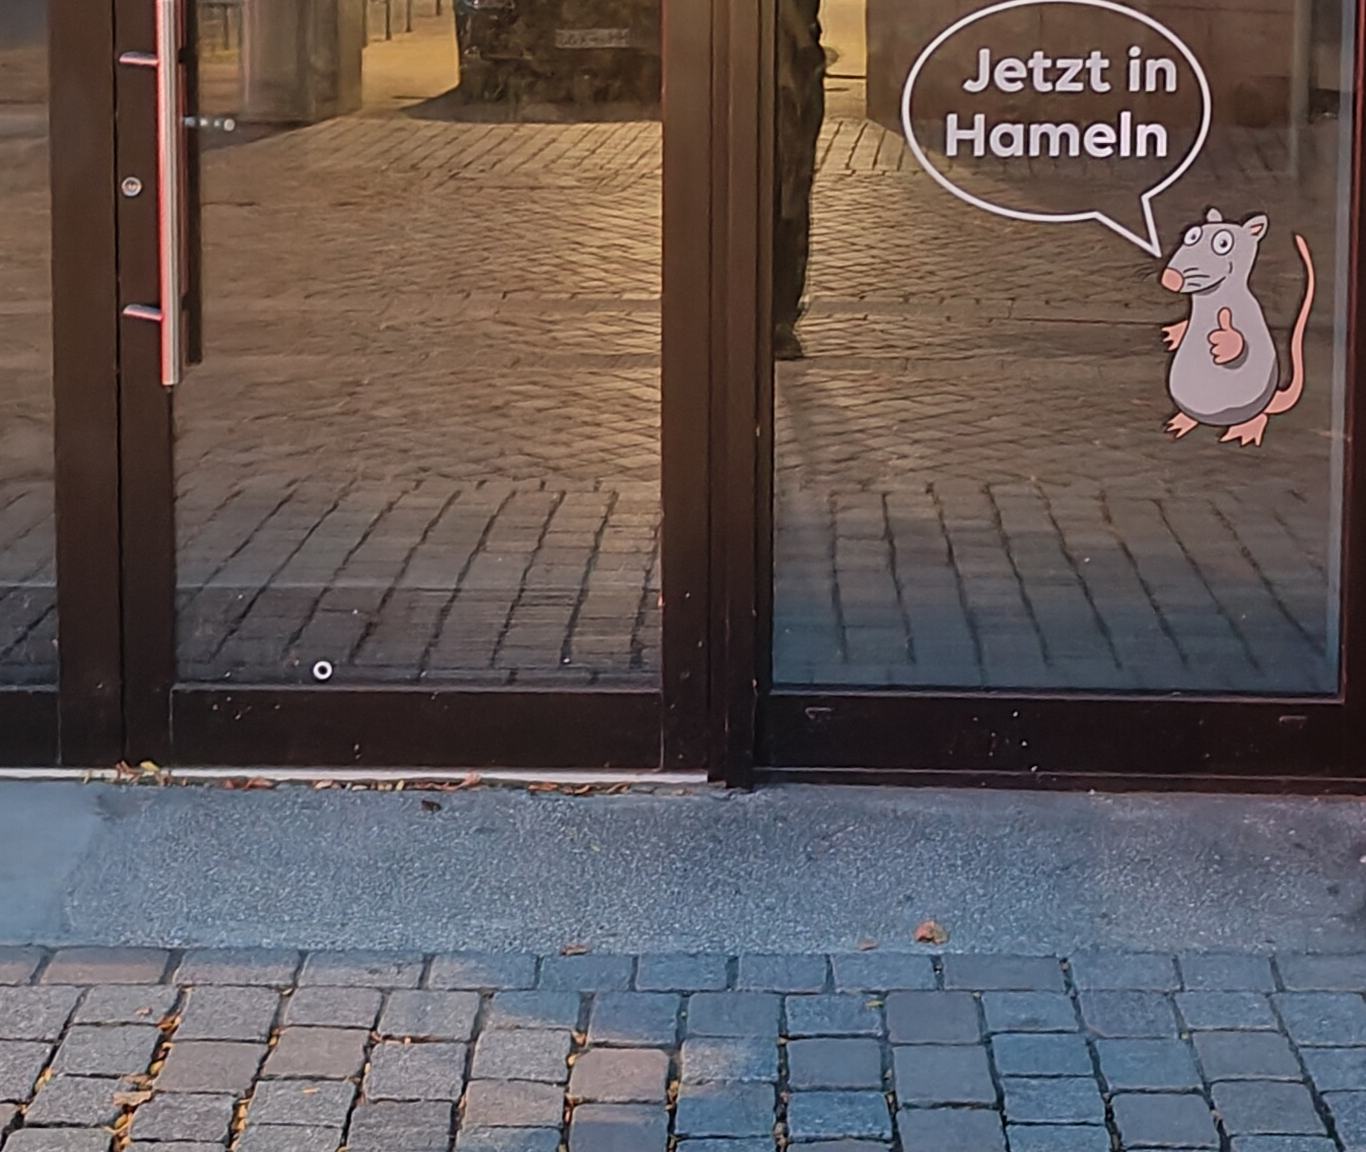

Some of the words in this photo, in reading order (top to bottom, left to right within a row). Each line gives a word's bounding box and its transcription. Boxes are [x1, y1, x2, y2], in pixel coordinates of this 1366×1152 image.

[962, 47, 1112, 94] Jetzt
[1127, 45, 1178, 94] in
[945, 110, 1168, 159] Hameln
